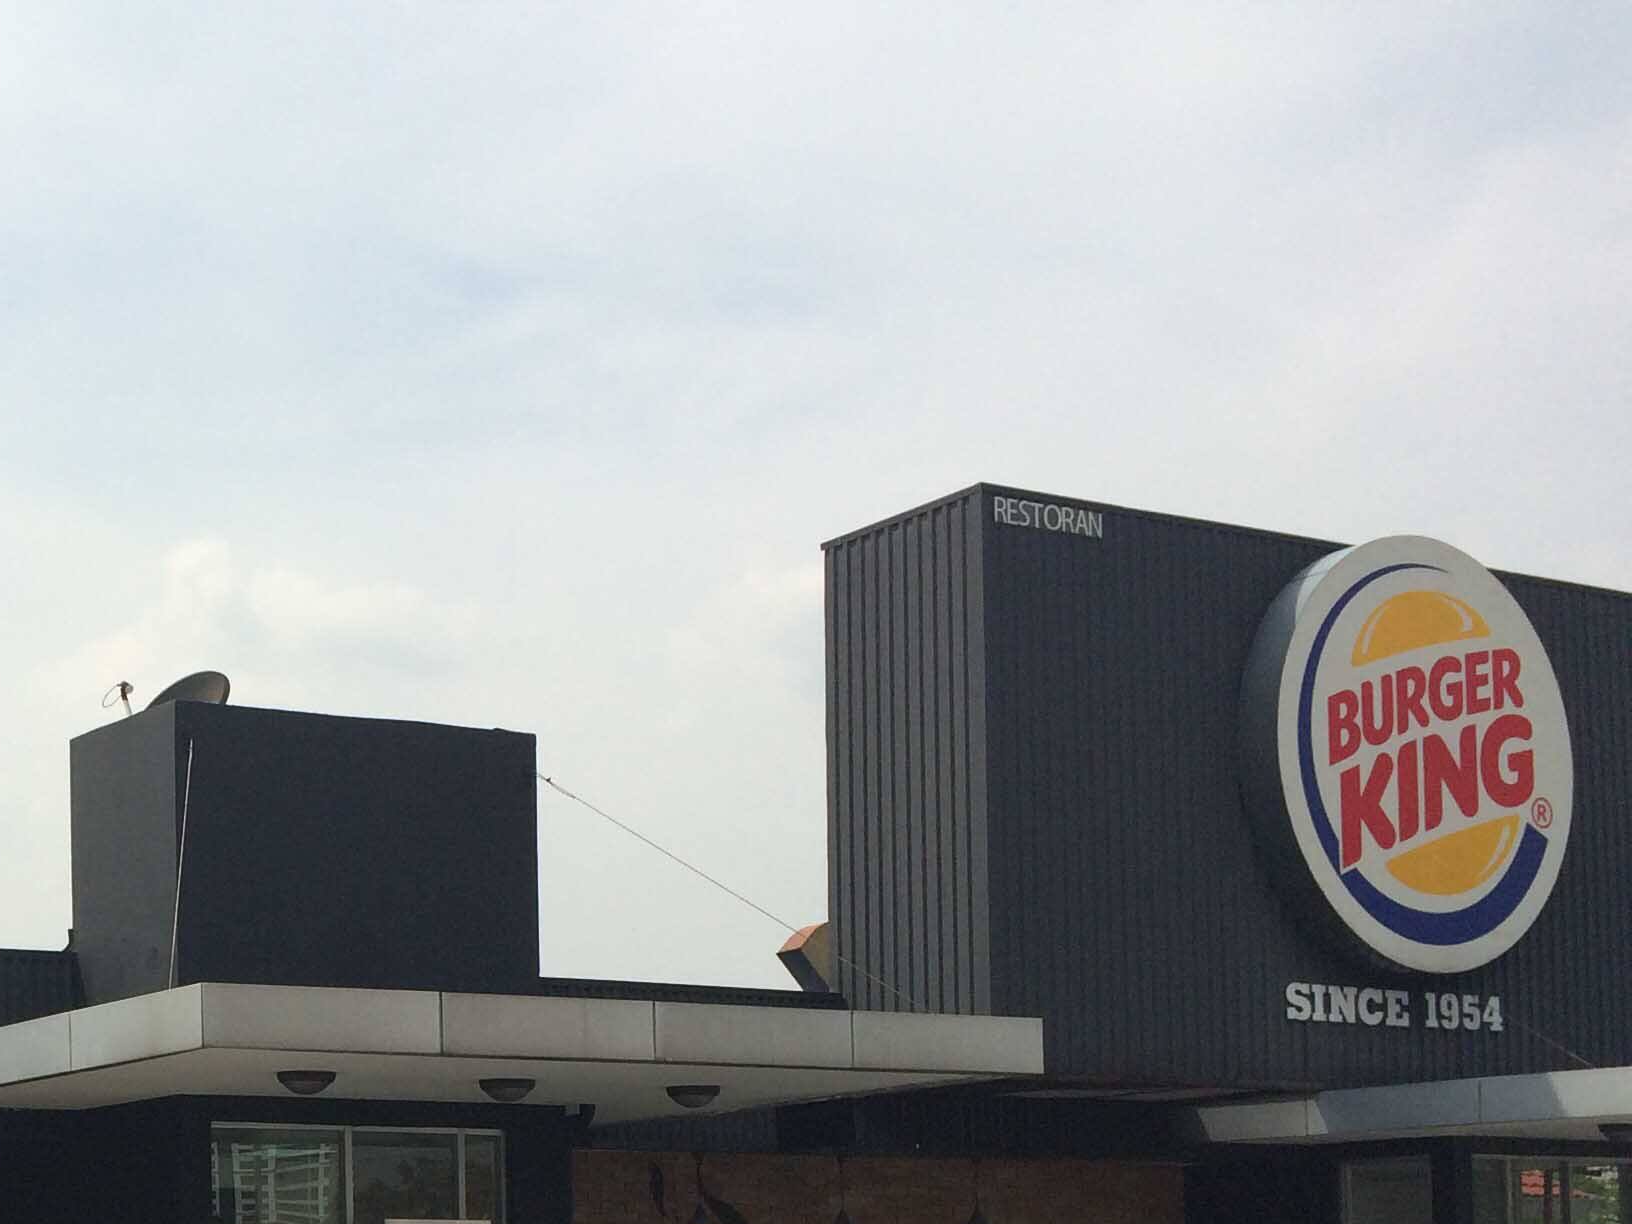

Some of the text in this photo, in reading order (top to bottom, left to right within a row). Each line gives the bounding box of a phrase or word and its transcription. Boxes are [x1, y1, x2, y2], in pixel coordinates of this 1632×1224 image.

[993, 495, 1104, 539] RESTORAN
[1327, 647, 1525, 766] BURGER
[1339, 713, 1536, 870] KING
[1284, 981, 1505, 1032] SINCE 1954
